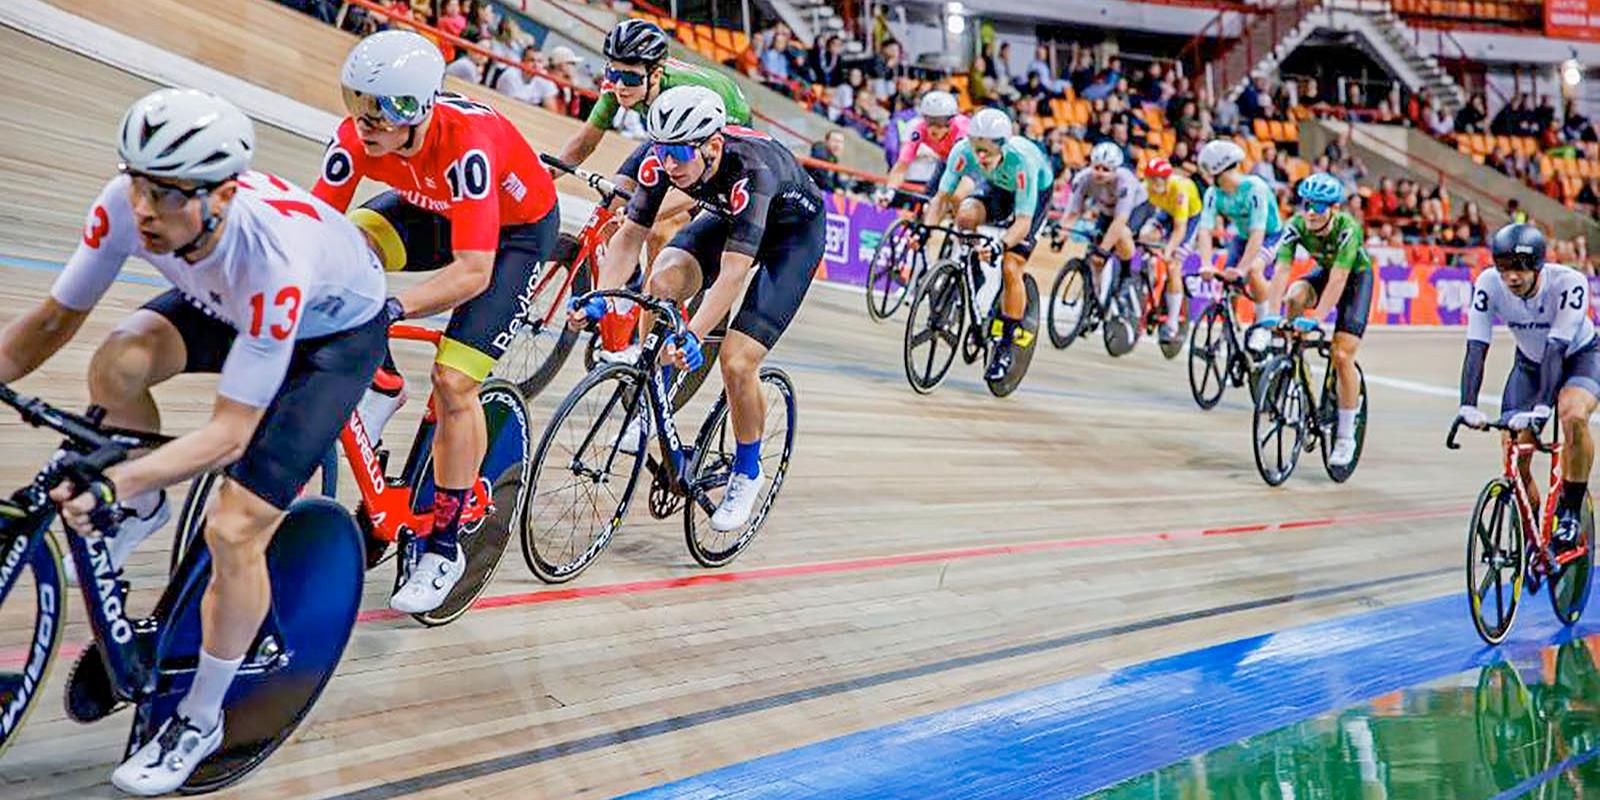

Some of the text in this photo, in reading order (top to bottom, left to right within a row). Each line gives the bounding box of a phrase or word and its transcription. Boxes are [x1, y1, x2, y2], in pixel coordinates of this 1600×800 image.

[444, 149, 491, 201] 10
[637, 155, 665, 187] 6
[730, 177, 750, 216] 6
[83, 205, 110, 250] 3
[1283, 226, 1299, 244] 7
[249, 286, 302, 341] 13
[1473, 287, 1490, 313] 3
[1559, 285, 1586, 311] 13
[350, 410, 385, 495] NARELLO
[84, 535, 133, 645] LNAGO
[2, 582, 55, 738] CORIM
